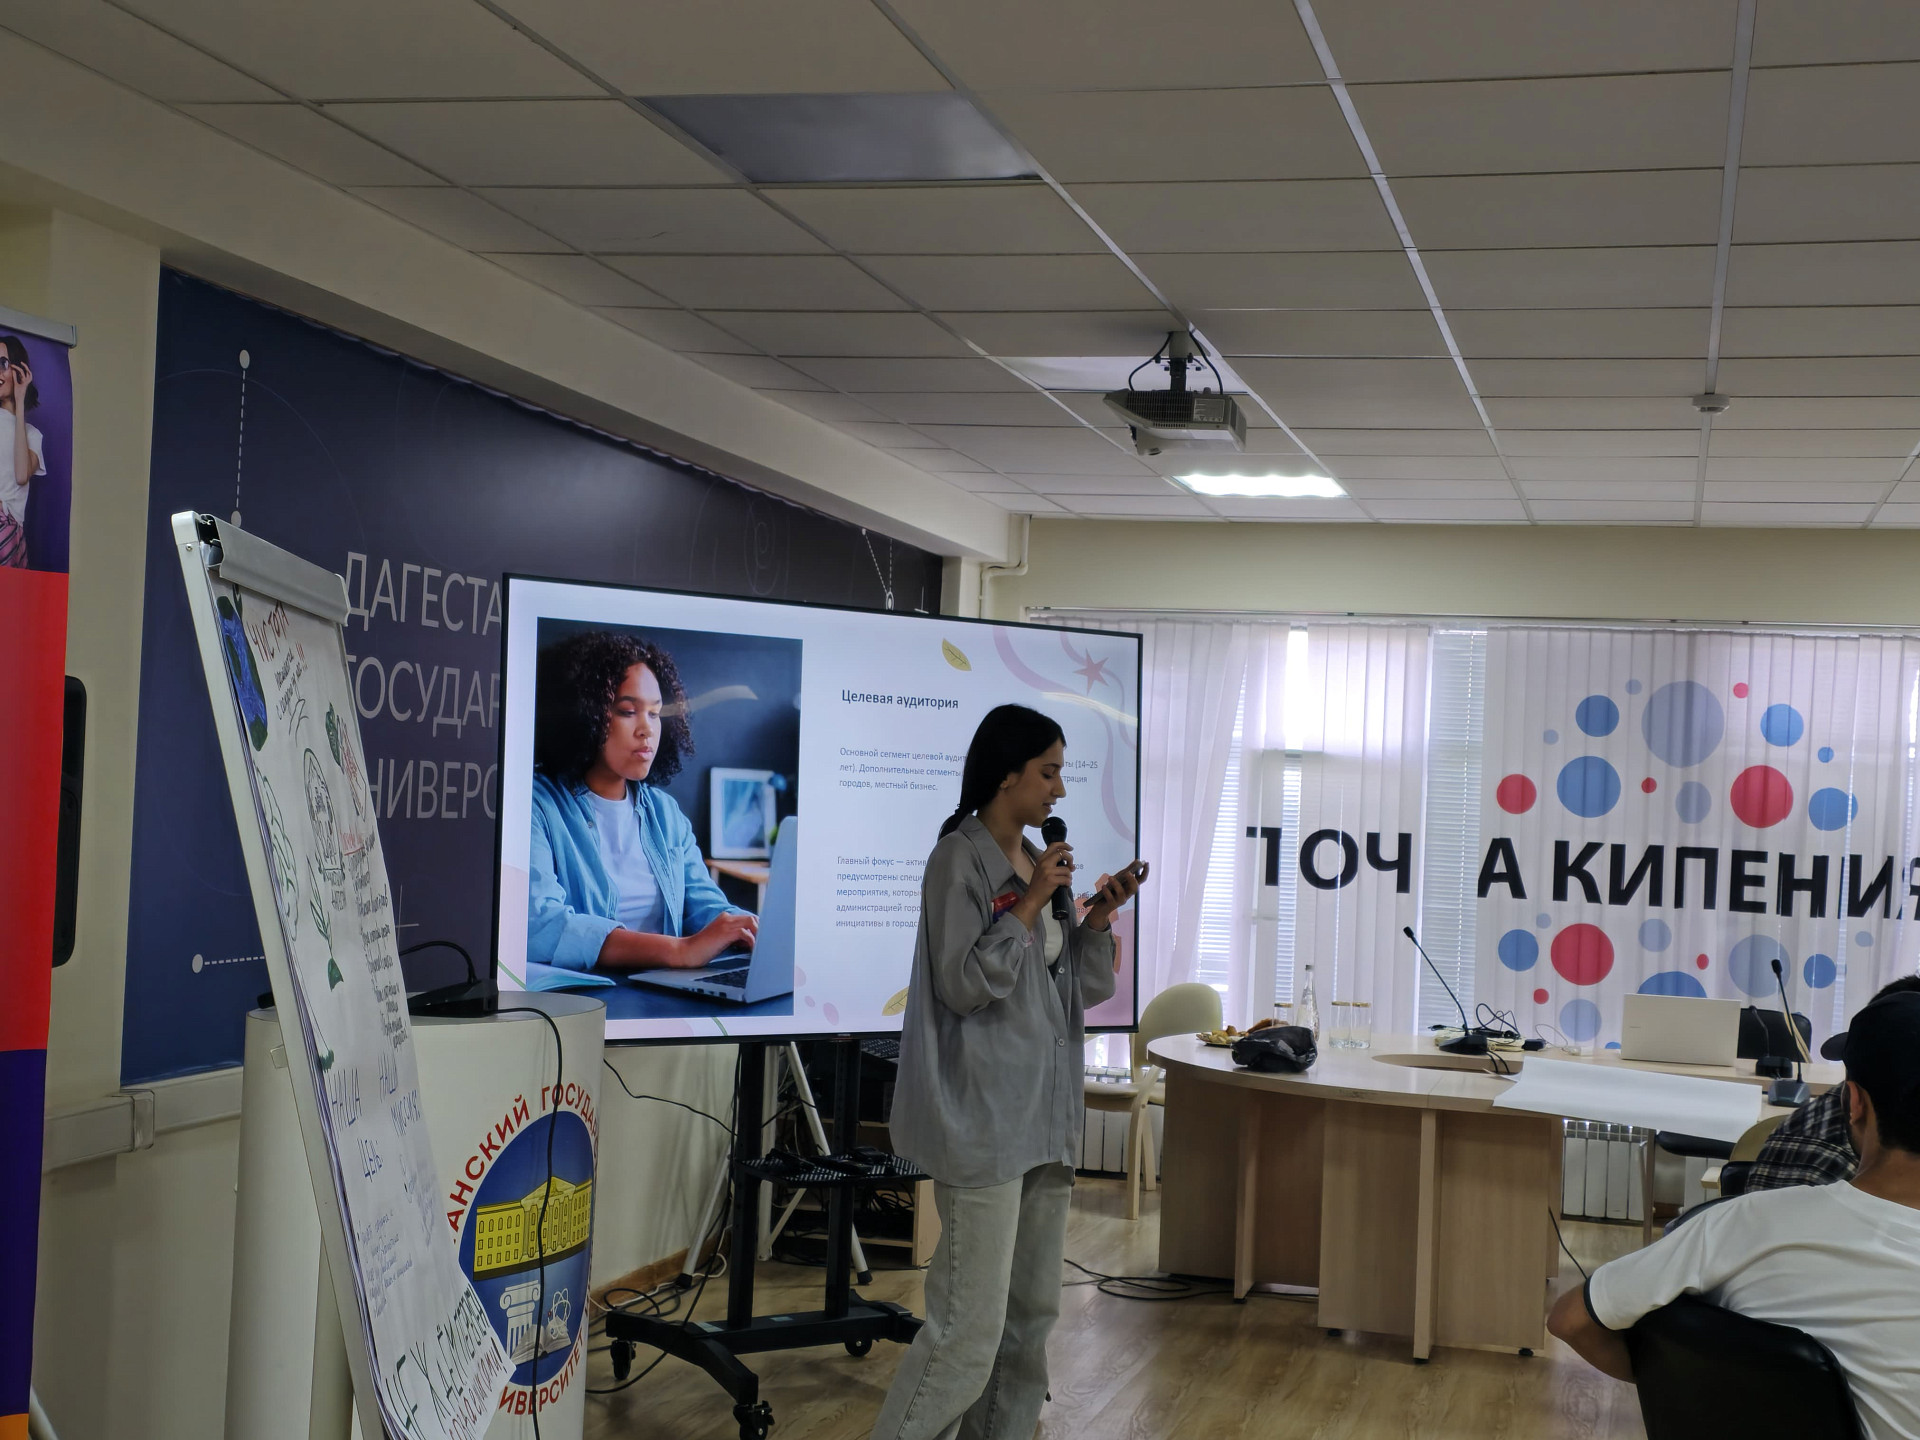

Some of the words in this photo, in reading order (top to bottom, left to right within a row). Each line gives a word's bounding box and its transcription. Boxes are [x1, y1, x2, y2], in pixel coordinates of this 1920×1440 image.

[346, 551, 501, 635] ДАГЕСТА
[842, 689, 893, 705] Целевая
[896, 695, 959, 710] аудитория
[840, 747, 879, 758] Основной
[880, 751, 911, 760] сегмент
[912, 752, 944, 762] целевой
[840, 764, 858, 773] лет).
[859, 763, 925, 776] Дополнительные
[839, 780, 873, 789] городов,
[875, 780, 908, 790] местный
[910, 781, 939, 791] бизнес.
[837, 856, 870, 866] Главный
[871, 857, 895, 867] фокус
[836, 873, 898, 883] предусмотрены
[836, 888, 891, 898] мероприятия,
[836, 902, 903, 913] администрацией
[835, 919, 884, 929] инициативы
[885, 920, 891, 928] в
[446, 1094, 530, 1244] АНСКИЙ
